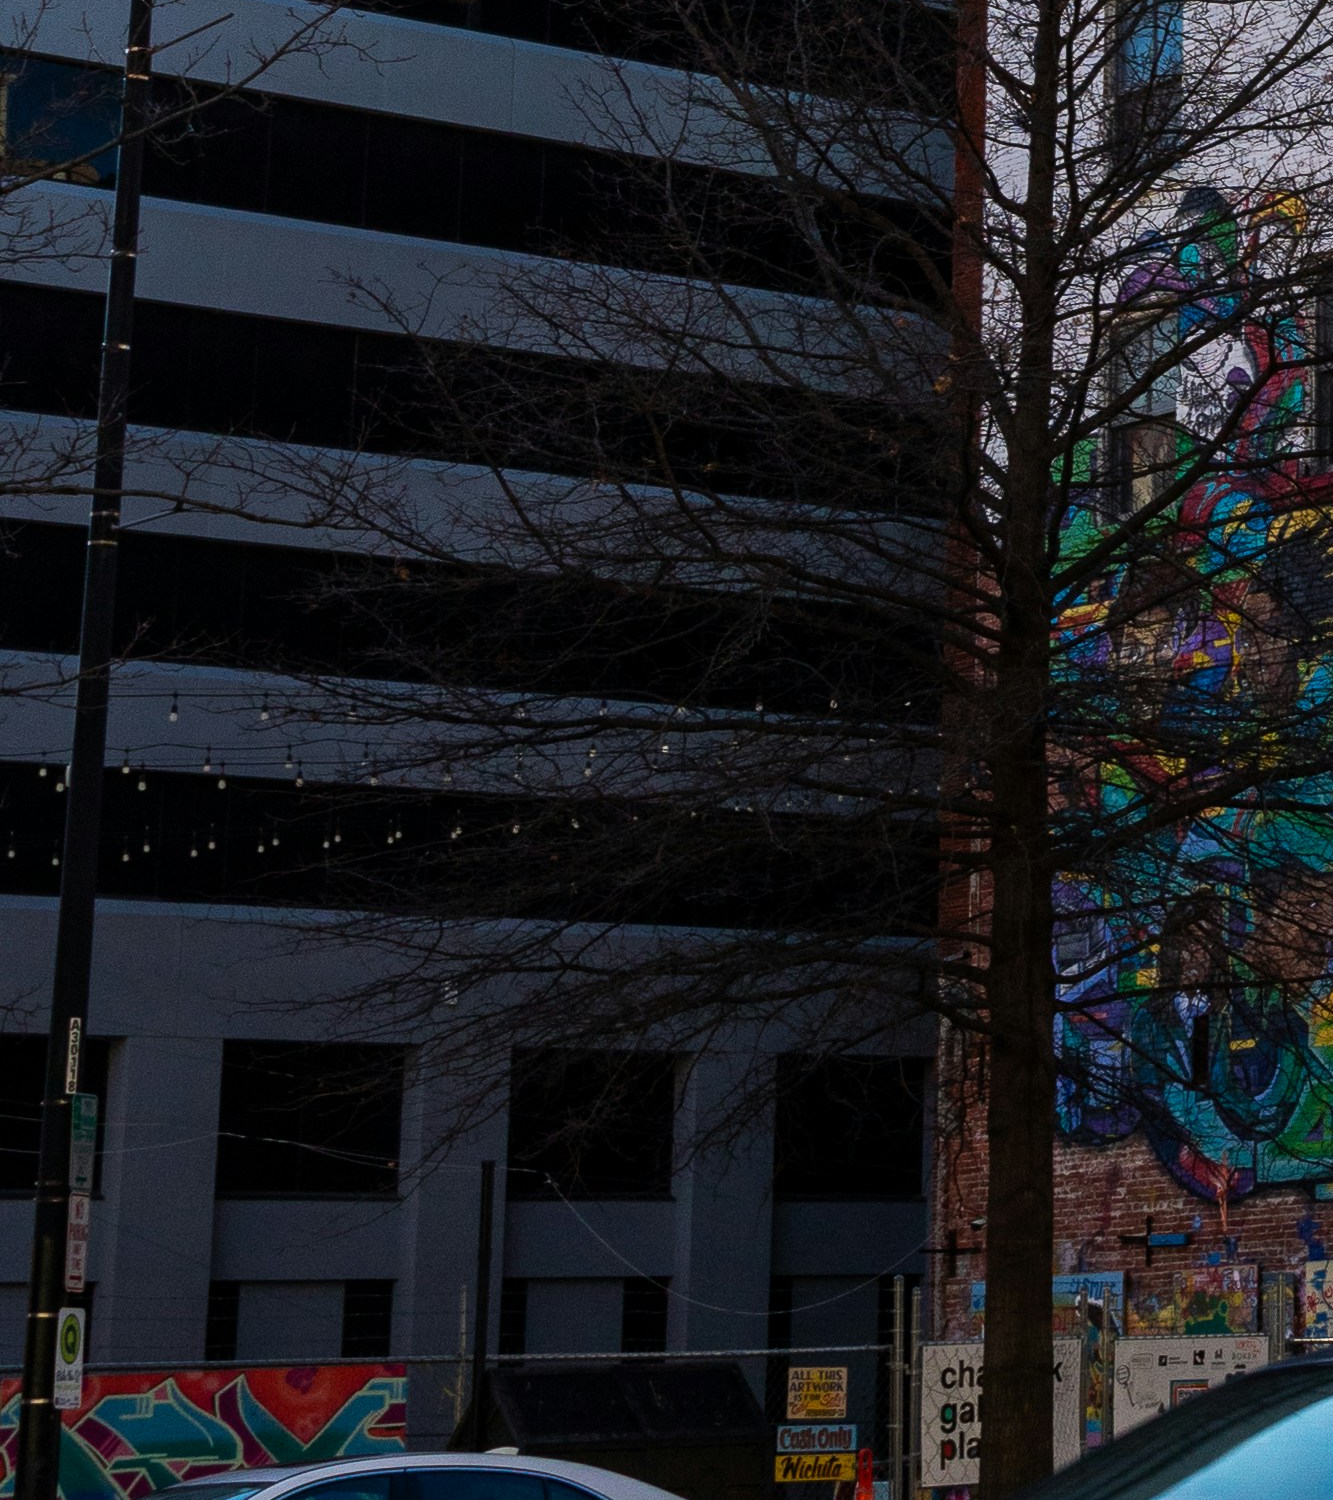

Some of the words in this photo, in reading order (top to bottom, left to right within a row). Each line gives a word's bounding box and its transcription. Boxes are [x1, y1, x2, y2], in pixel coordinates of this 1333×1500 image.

[789, 1381, 844, 1393] ARTWORK
[791, 1370, 814, 1381] ALL
[818, 1369, 843, 1381] THIS
[940, 1394, 985, 1434] gal
[779, 1427, 816, 1450] Cash
[817, 1426, 852, 1450] Only
[940, 1431, 983, 1470] pla
[780, 1455, 843, 1480] Wichita
